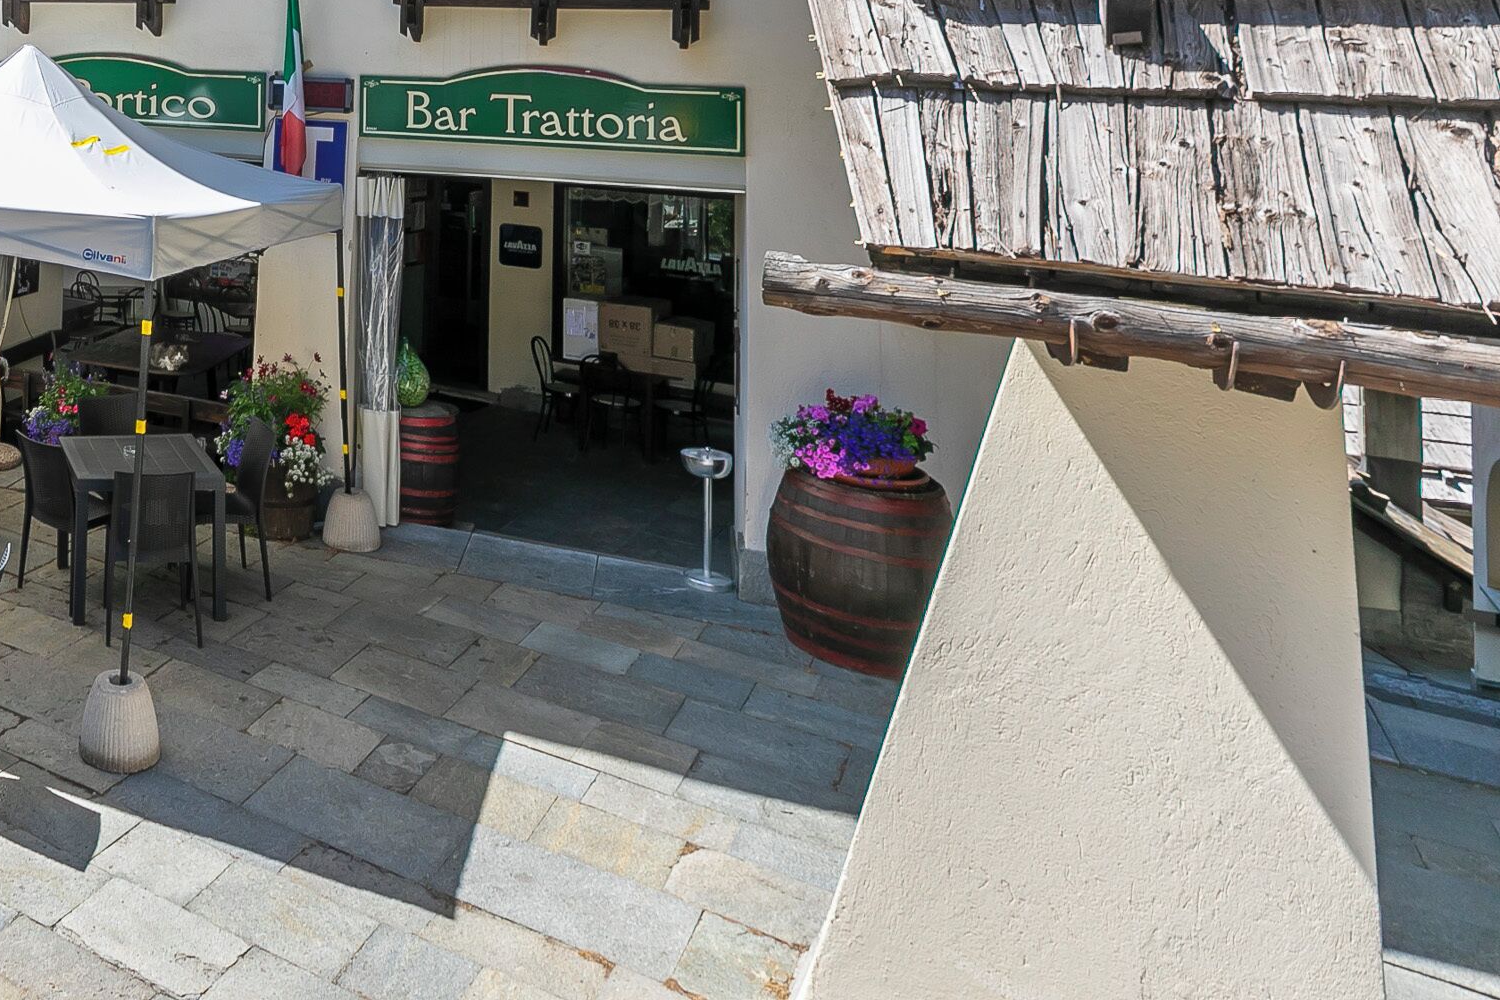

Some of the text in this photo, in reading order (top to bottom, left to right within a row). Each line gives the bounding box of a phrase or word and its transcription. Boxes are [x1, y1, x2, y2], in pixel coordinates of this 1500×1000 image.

[406, 90, 688, 143] Bar Trattoria
[503, 239, 538, 252] LAVAZZA
